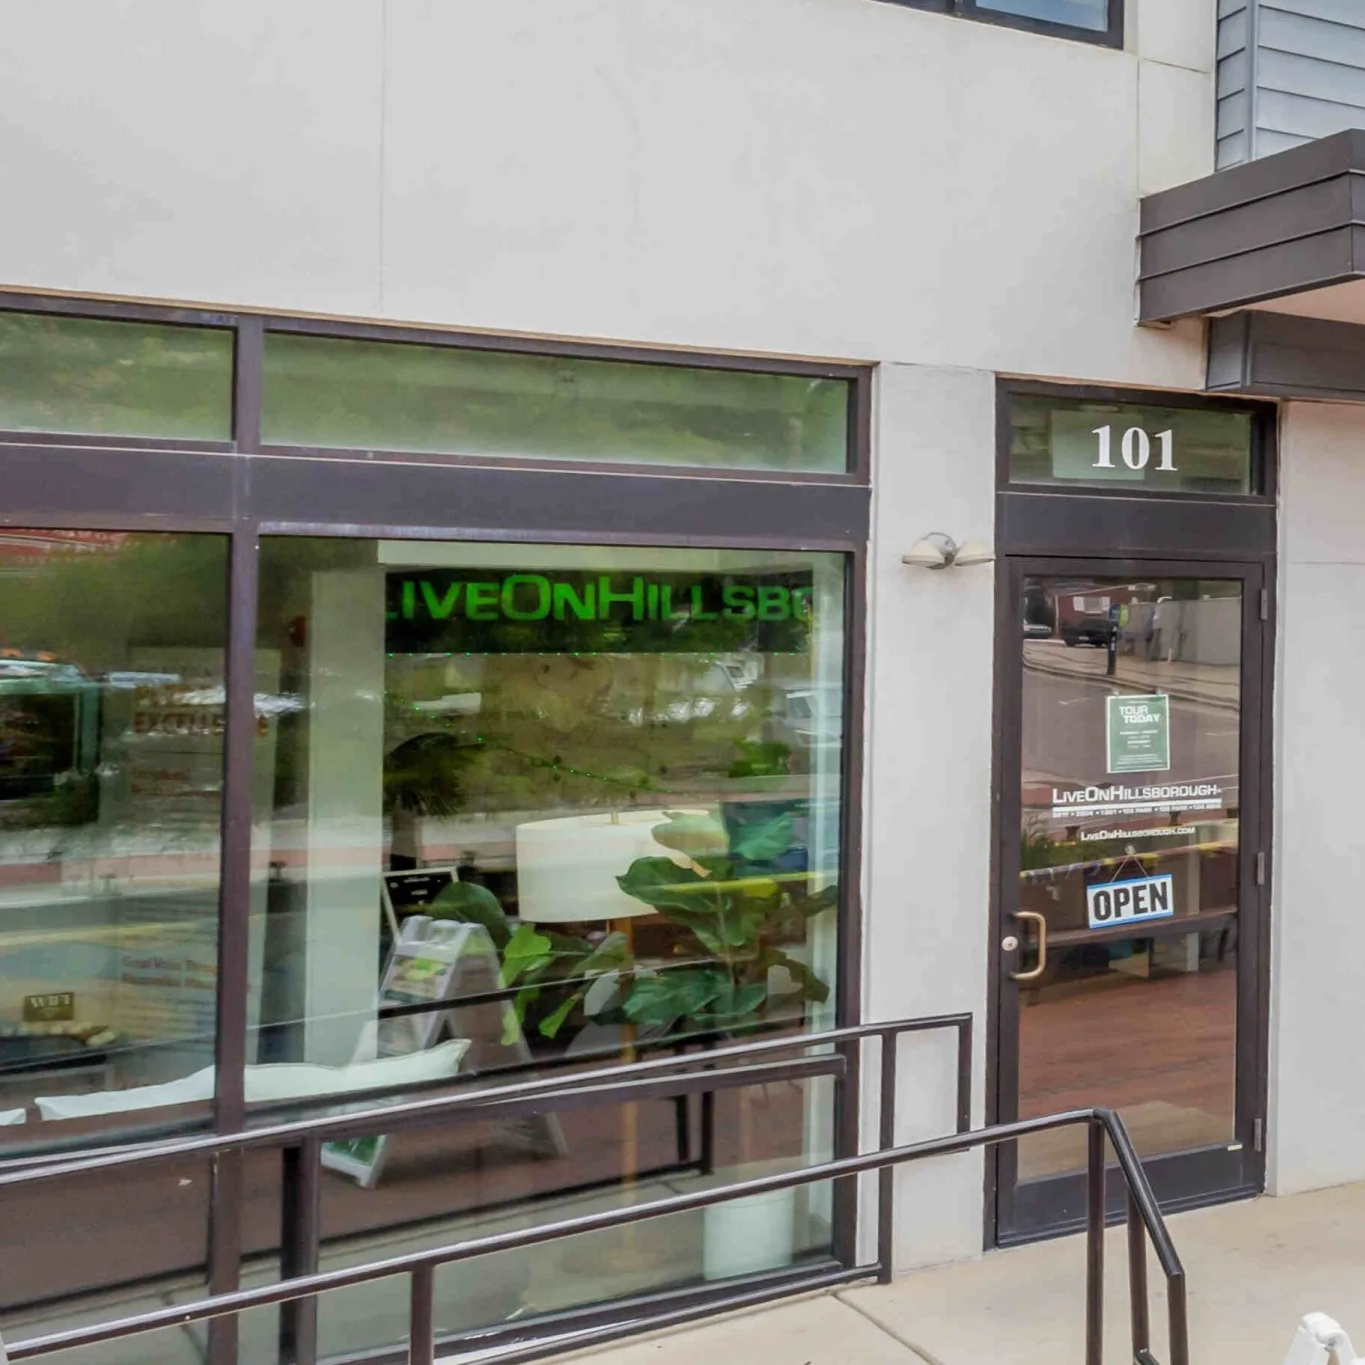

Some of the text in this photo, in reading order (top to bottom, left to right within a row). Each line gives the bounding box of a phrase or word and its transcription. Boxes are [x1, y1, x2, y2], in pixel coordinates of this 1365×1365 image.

[1092, 425, 1178, 471] 101
[1119, 705, 1149, 715] TOUR
[1123, 714, 1161, 724] TODAY
[1093, 881, 1169, 922] OPEN
